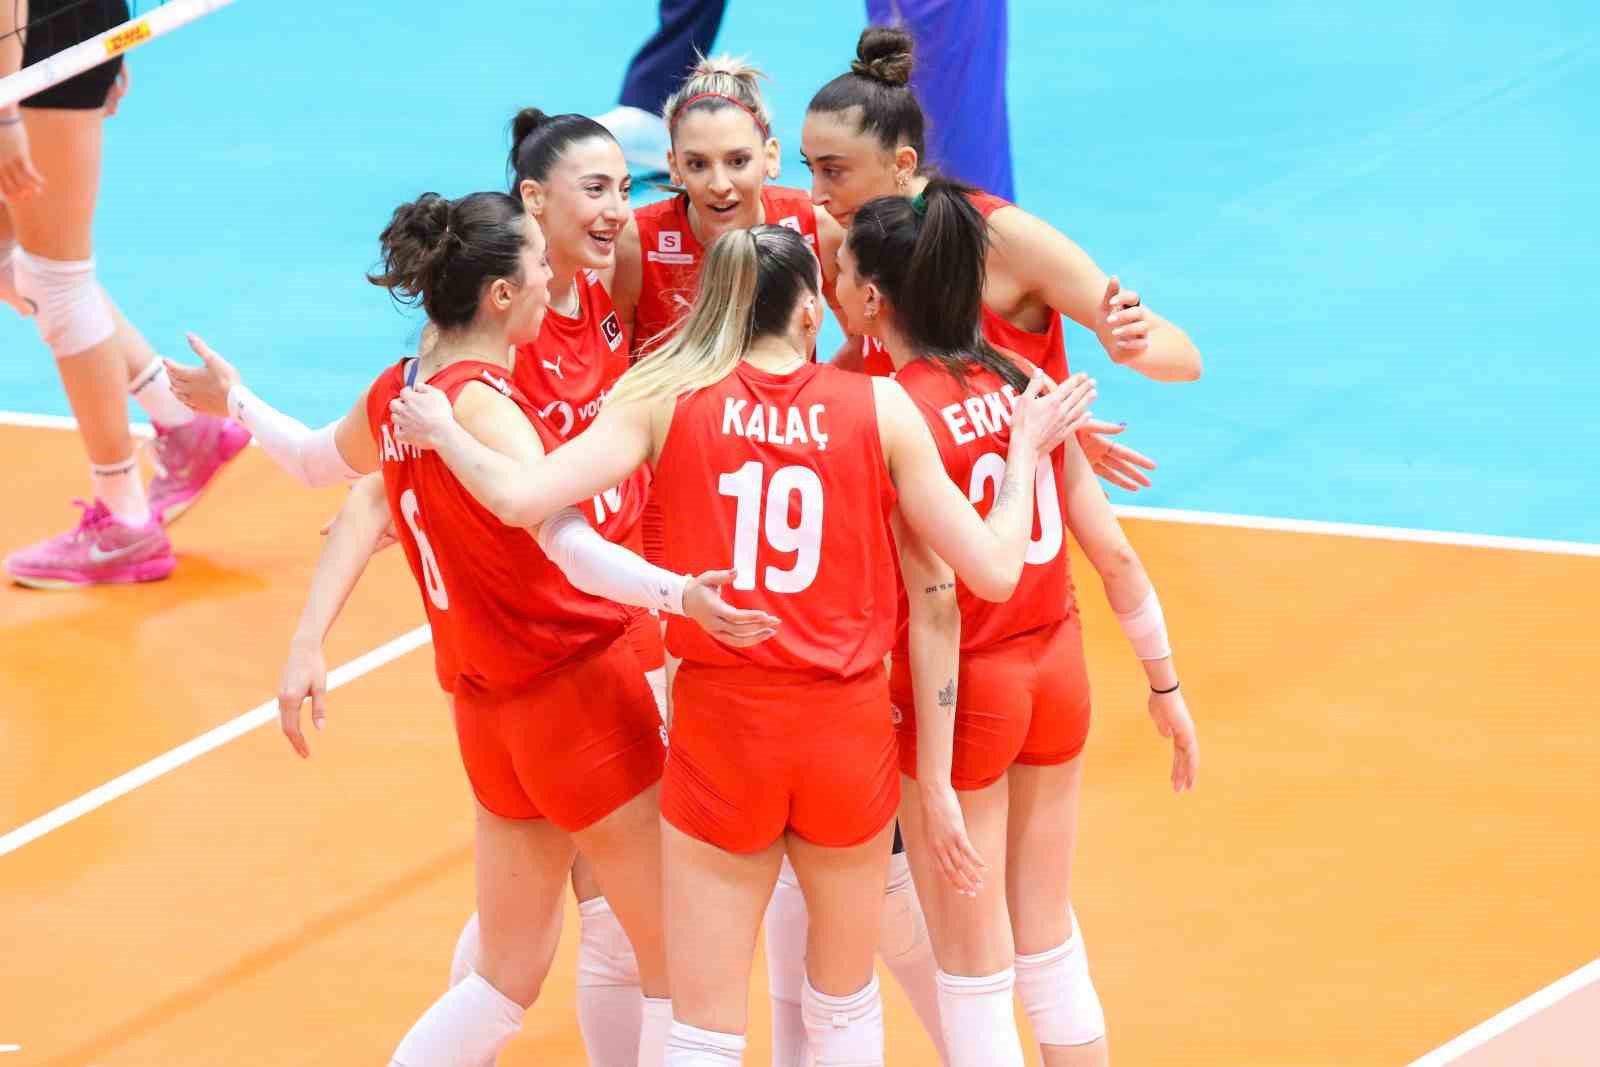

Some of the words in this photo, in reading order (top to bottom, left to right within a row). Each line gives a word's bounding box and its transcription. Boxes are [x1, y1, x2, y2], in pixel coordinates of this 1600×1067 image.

[663, 235, 676, 248] S
[578, 389, 607, 421] vod
[721, 396, 829, 451] KALAÇ
[400, 488, 449, 611] 6
[718, 460, 824, 594] 19
